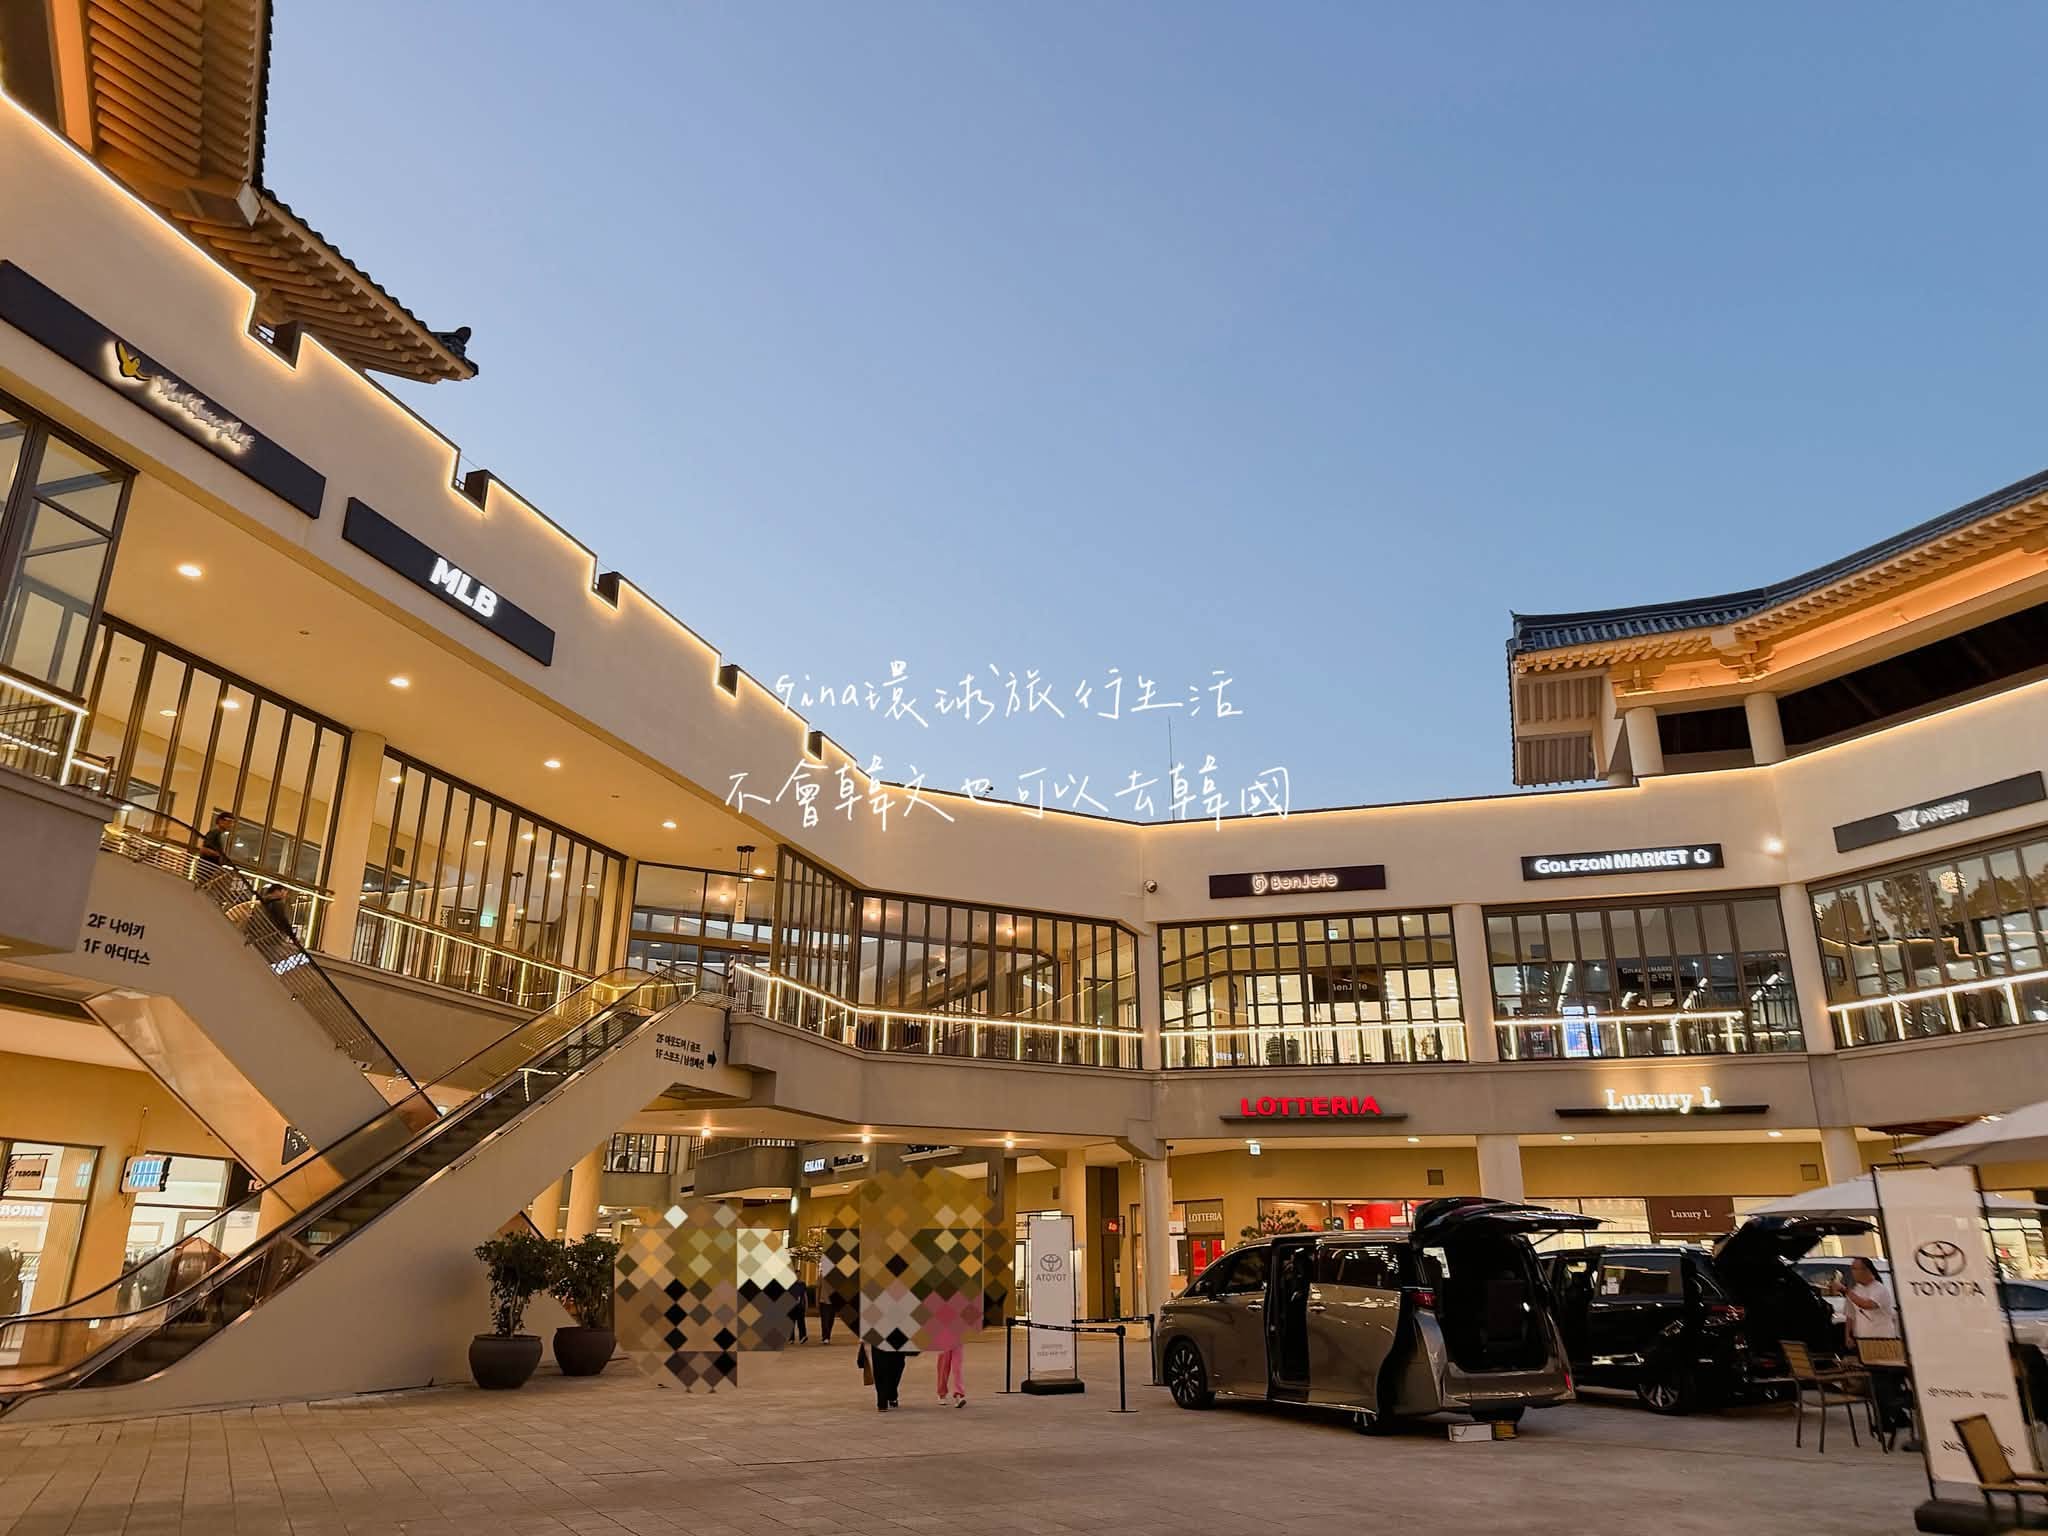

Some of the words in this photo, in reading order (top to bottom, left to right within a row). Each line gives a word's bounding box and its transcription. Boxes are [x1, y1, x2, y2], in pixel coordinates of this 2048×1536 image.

[430, 557, 497, 617] MLB
[87, 913, 107, 928] 2F
[109, 919, 145, 940] 나이키
[84, 938, 102, 953] 1F
[104, 943, 151, 966] 아디다스
[1240, 1096, 1382, 1117] LOTTERIA
[1605, 1088, 1693, 1114] Luxury
[1701, 1086, 1721, 1108] L
[1188, 1211, 1223, 1223] LOTTERIA
[1670, 1209, 1702, 1220] Luxury
[1704, 1209, 1712, 1218] L
[1909, 1280, 1986, 1297] TOYOTA
